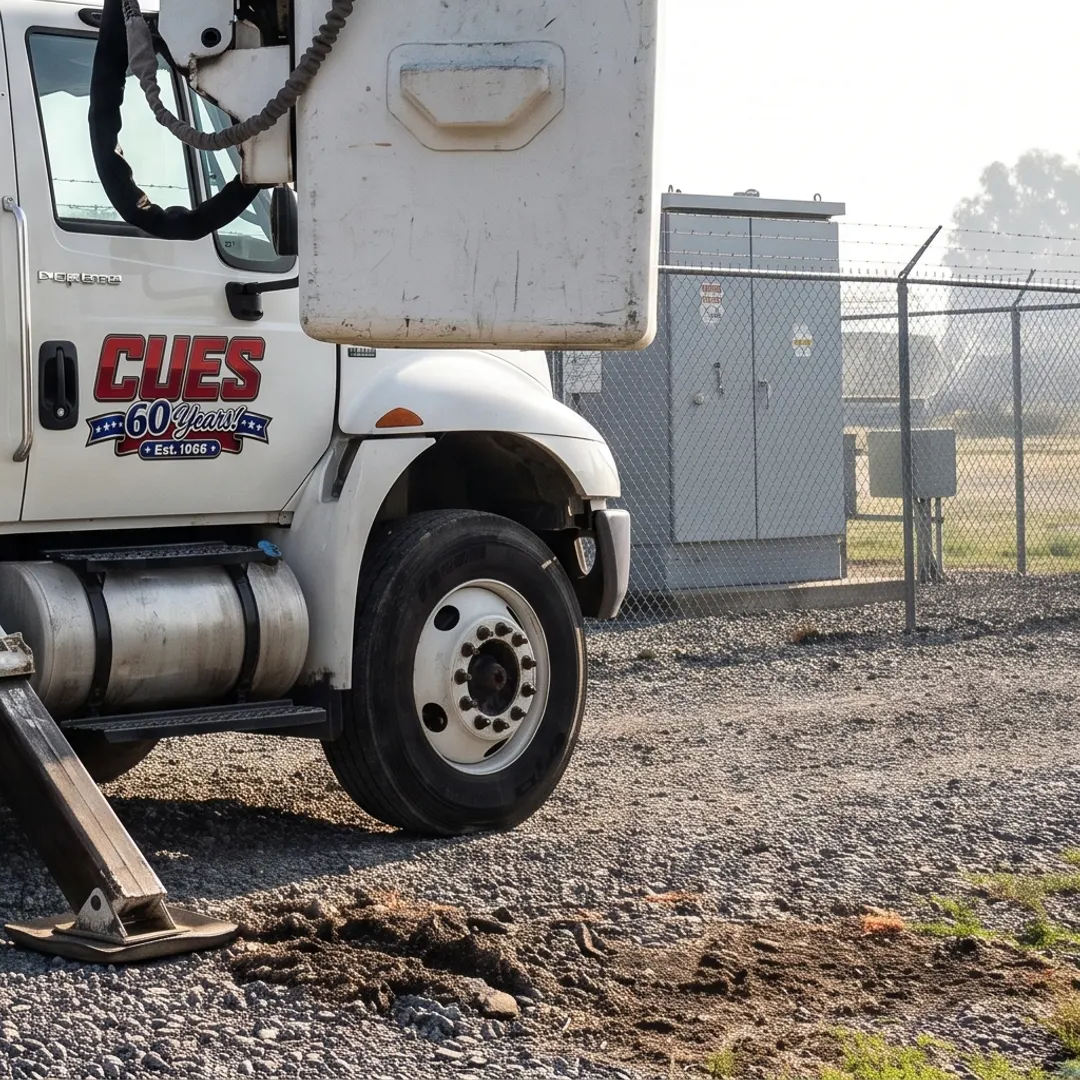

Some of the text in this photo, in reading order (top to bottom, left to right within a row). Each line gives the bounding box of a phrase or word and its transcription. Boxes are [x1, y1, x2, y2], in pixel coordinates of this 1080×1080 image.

[93, 334, 266, 402] CUES
[125, 399, 247, 441] 60 Years!
[154, 443, 207, 456] Est. 1066
